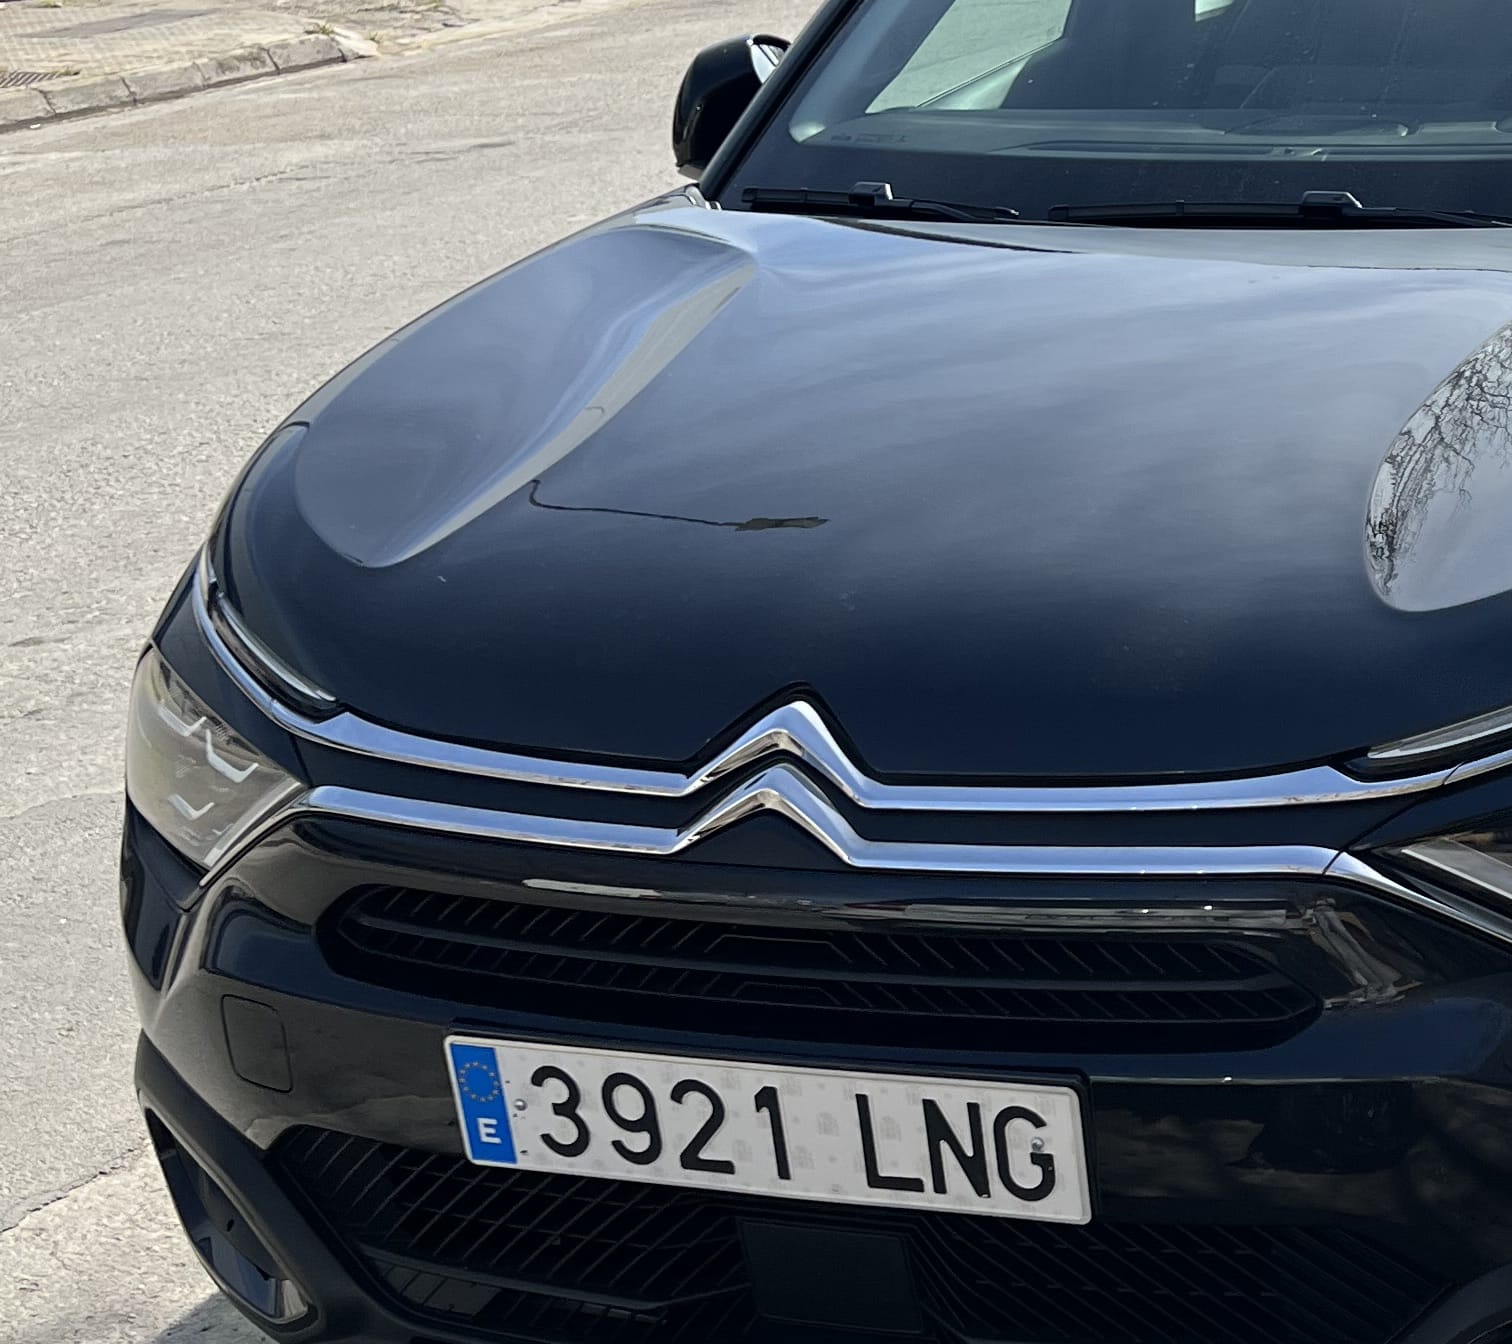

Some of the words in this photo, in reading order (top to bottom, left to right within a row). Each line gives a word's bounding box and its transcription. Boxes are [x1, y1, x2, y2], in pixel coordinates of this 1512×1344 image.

[477, 1117, 501, 1145] E
[530, 1064, 791, 1180] 3921
[855, 1092, 1056, 1202] LNG
